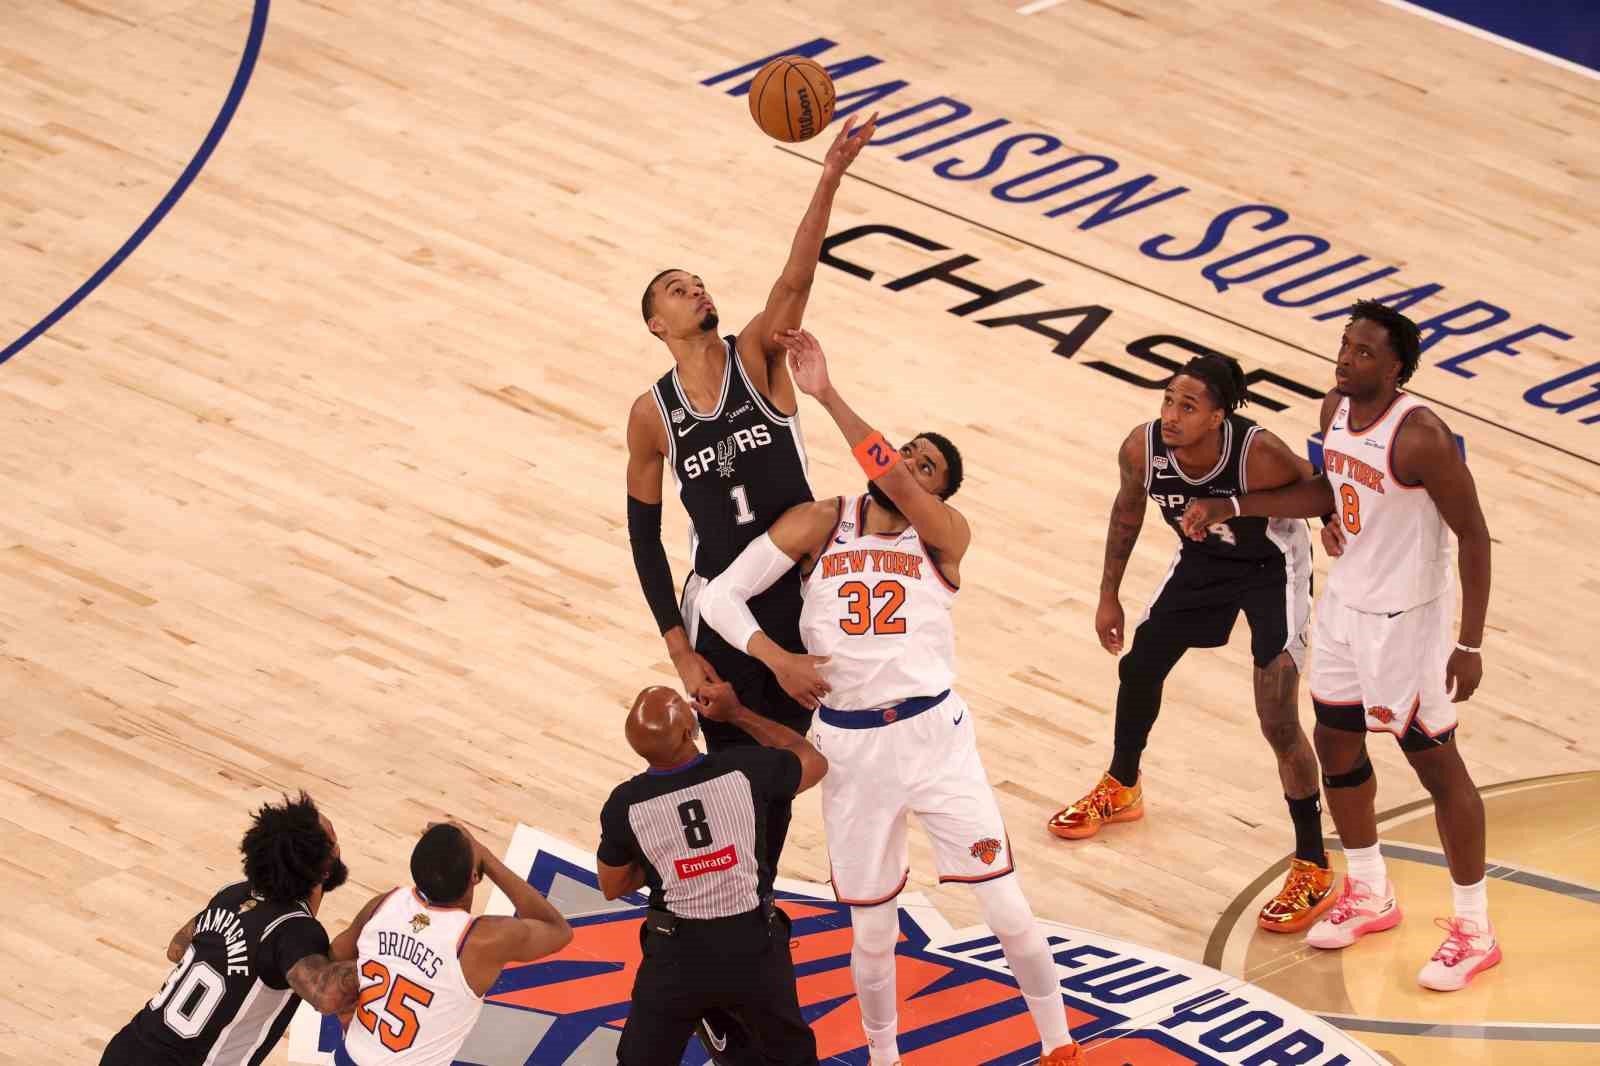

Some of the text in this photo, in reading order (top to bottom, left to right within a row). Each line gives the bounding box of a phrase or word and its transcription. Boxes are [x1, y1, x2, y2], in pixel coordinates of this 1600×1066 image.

[683, 423, 772, 479] SPURS
[729, 484, 755, 526] 1
[1340, 483, 1361, 535] 8
[821, 549, 923, 581] NEW YORK
[837, 580, 906, 635] 32
[677, 798, 713, 849] 8
[681, 853, 733, 874] Emirates
[378, 931, 443, 980] BRIDGES
[356, 959, 435, 1053] 25
